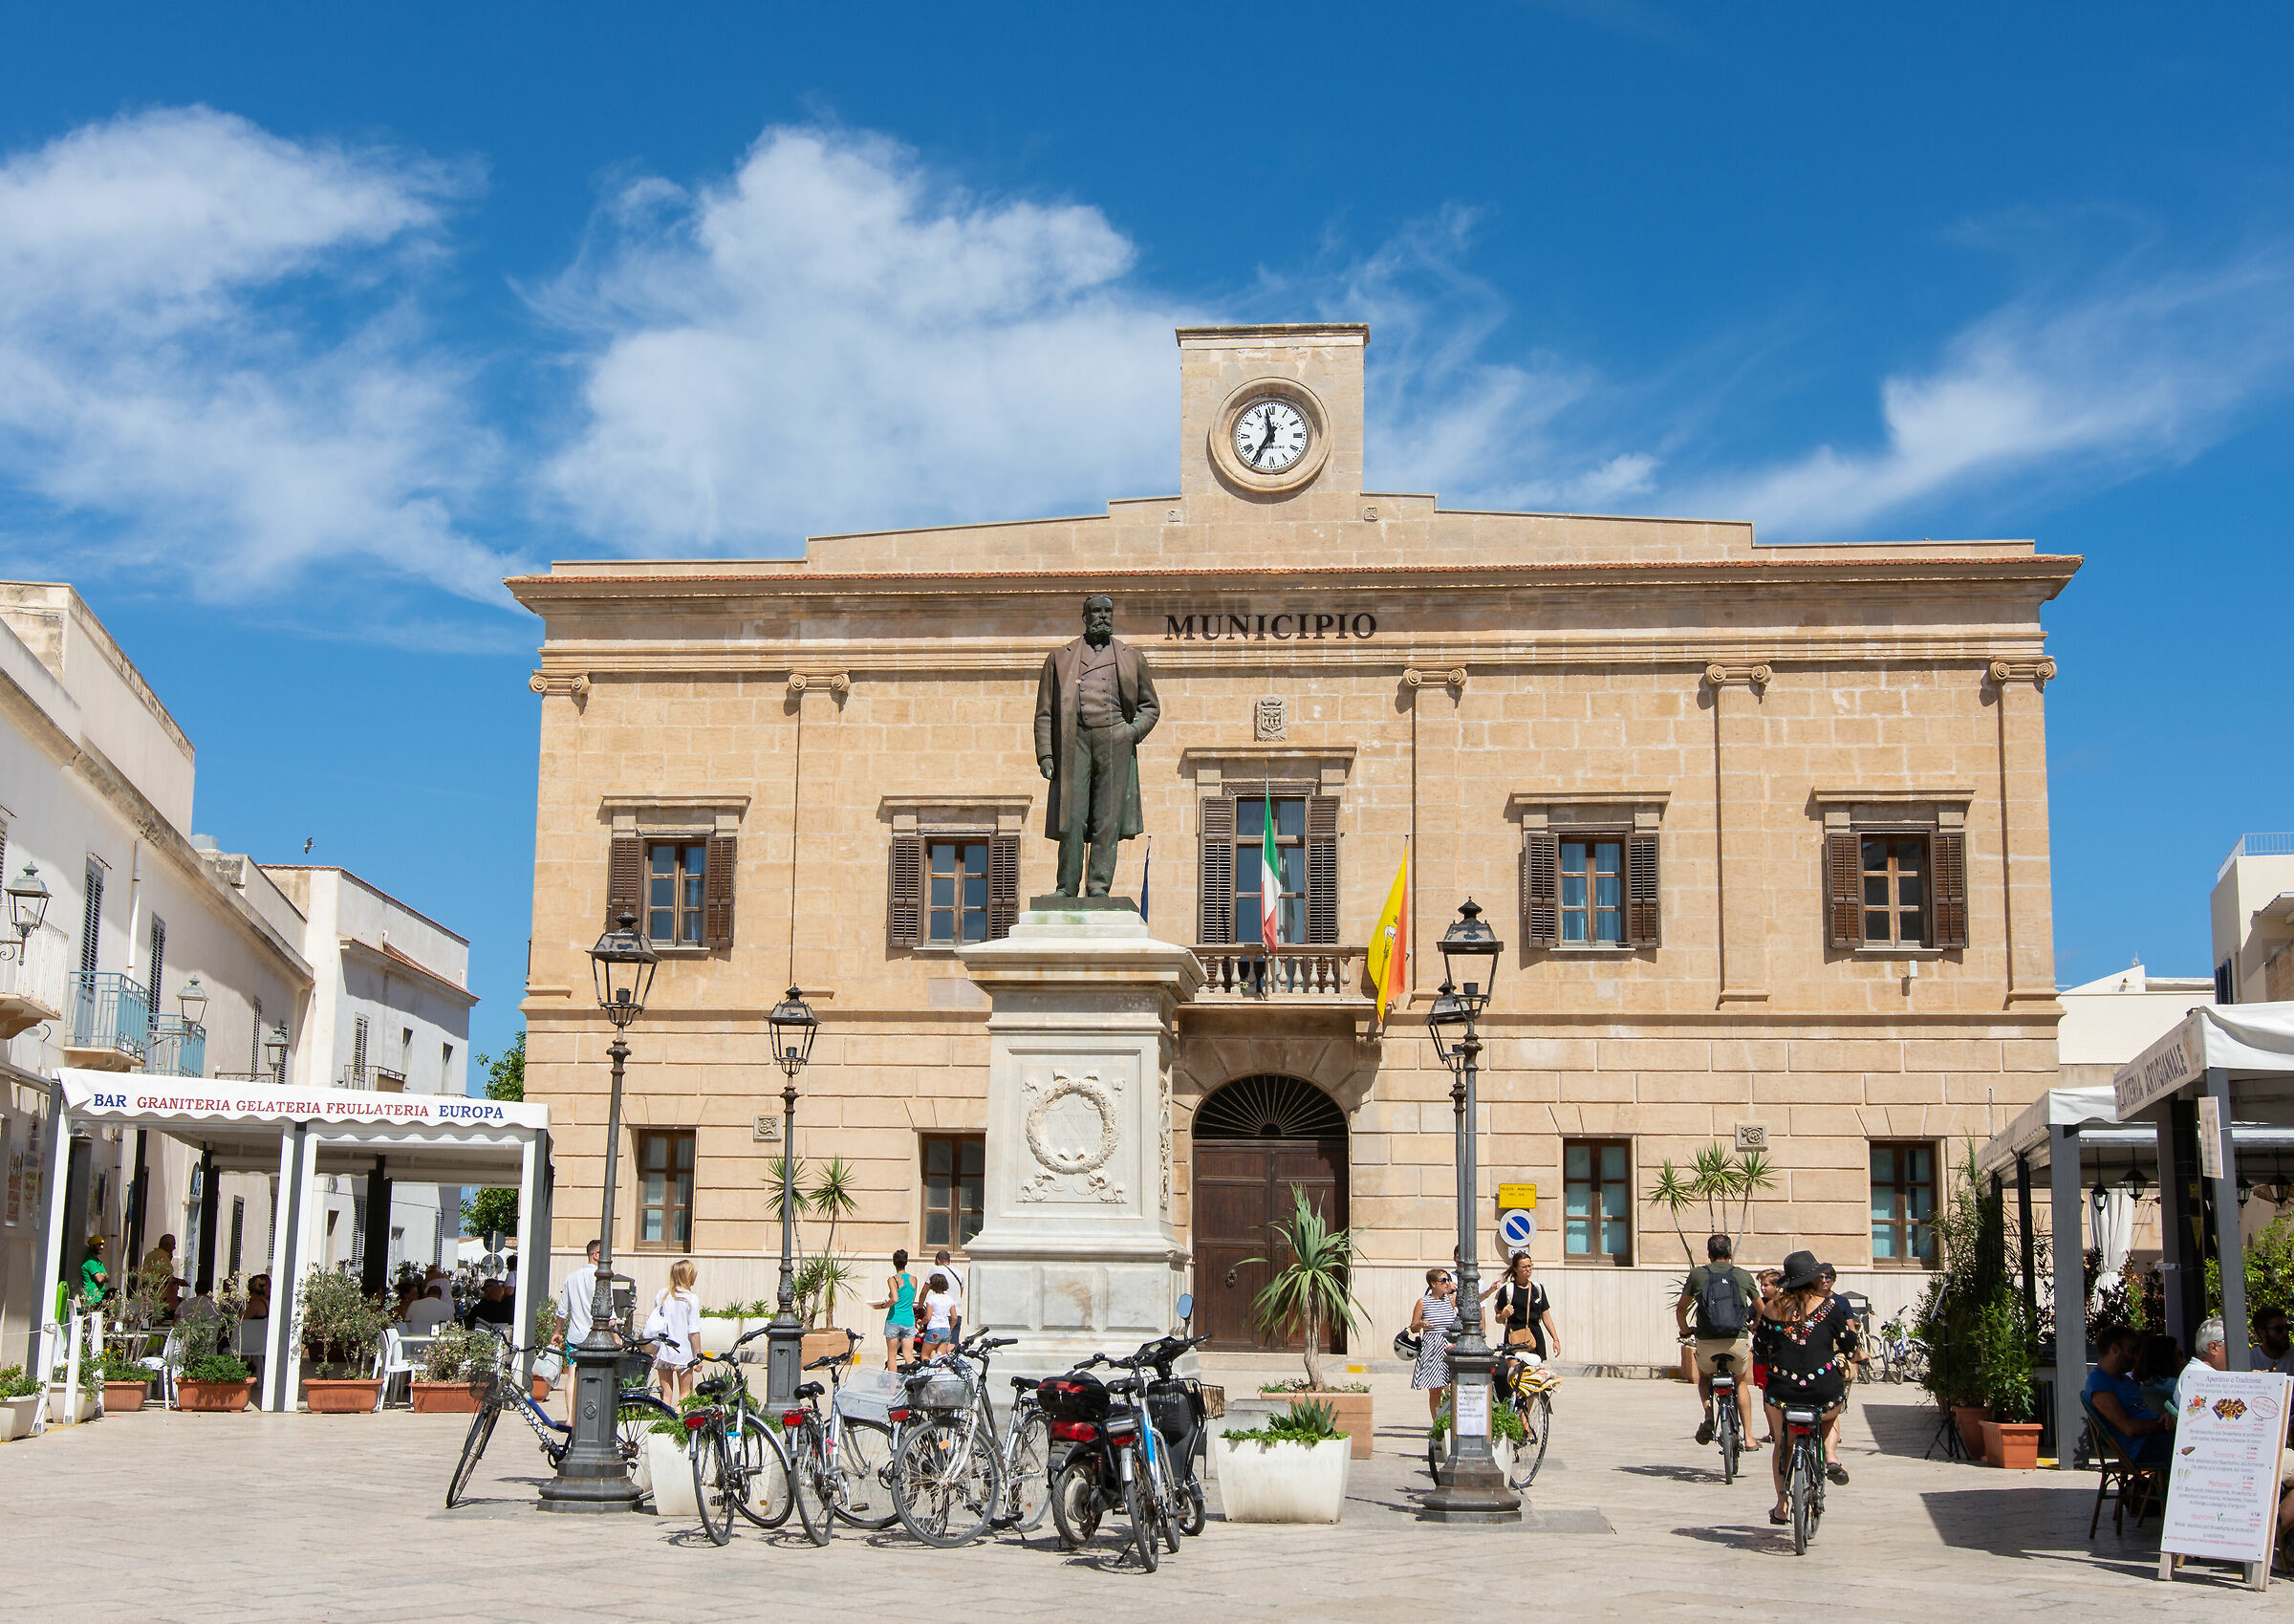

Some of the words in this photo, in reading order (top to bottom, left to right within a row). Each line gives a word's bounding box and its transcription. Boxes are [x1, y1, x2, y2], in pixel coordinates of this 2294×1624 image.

[1164, 613, 1377, 640] MUNICIPIO
[2144, 1044, 2188, 1095] ARTIGIANALE
[93, 1093, 127, 1107] BAR
[137, 1096, 230, 1111] GRANITERIA
[236, 1100, 321, 1114] GELATERIA
[326, 1102, 429, 1116] FRULLATERIA
[439, 1105, 504, 1118] EUROPA
